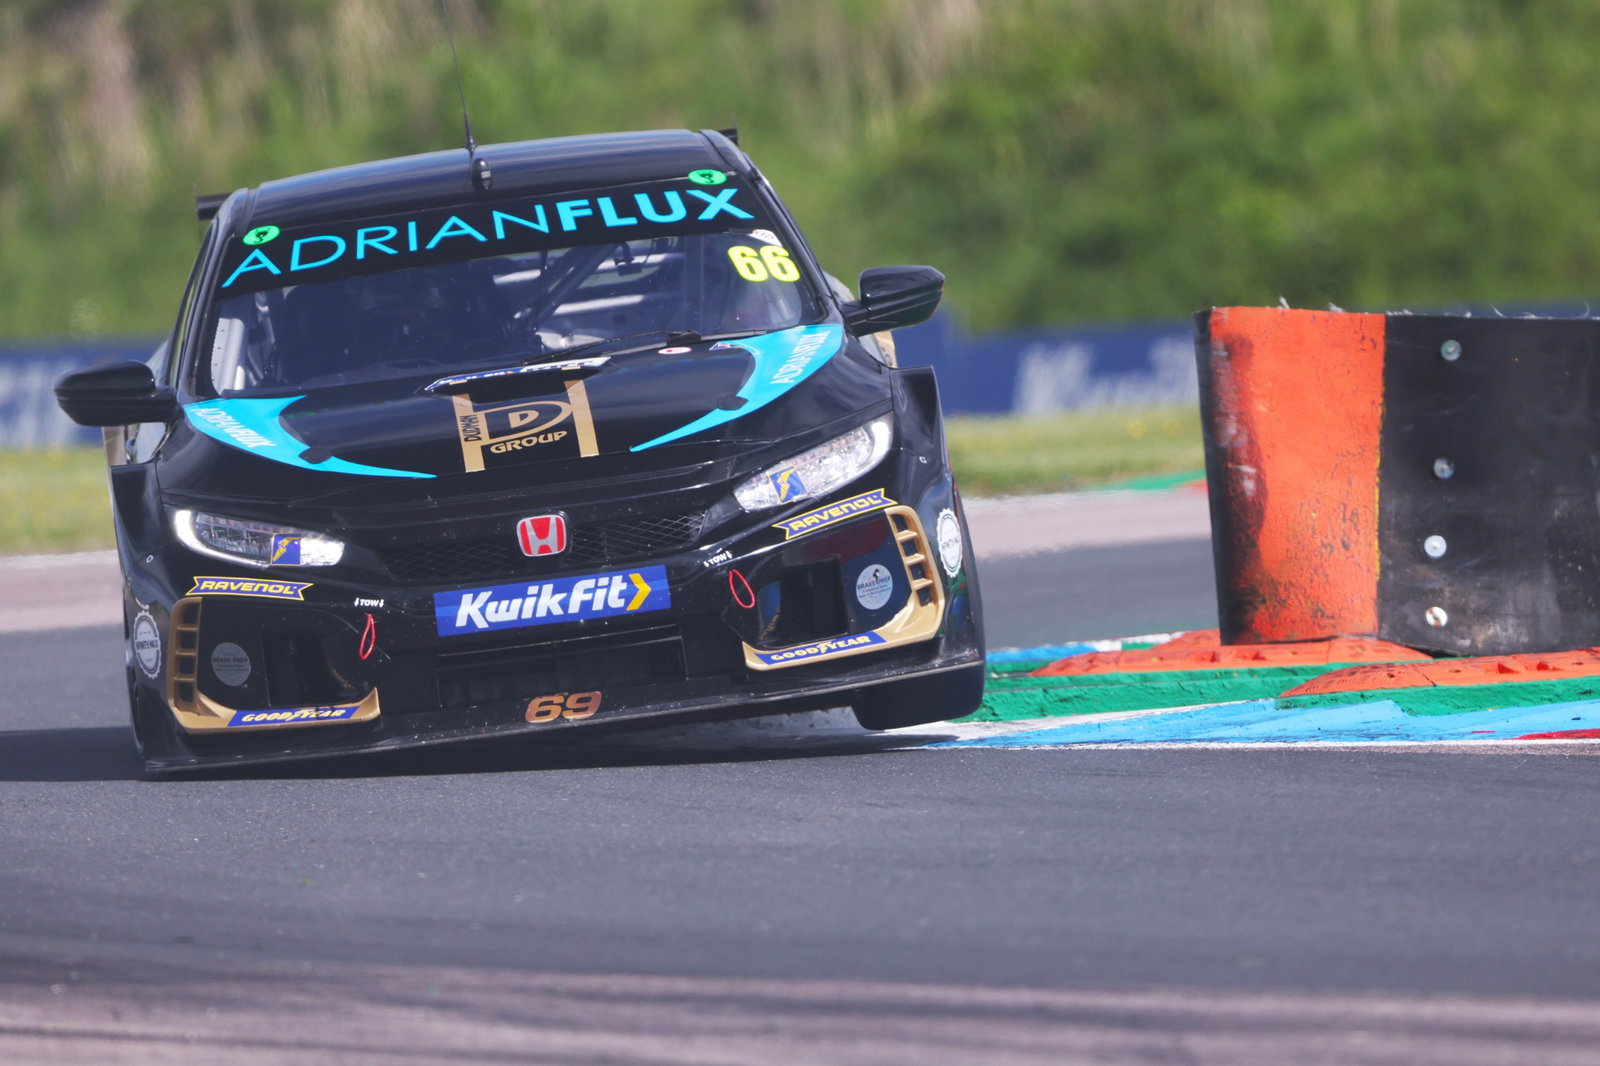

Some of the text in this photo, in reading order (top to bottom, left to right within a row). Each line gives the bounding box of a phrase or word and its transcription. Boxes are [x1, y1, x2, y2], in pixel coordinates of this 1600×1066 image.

[222, 188, 754, 287] ADRIANFLUX
[728, 246, 800, 282] 66
[490, 431, 568, 454] GROUP
[789, 495, 882, 531] RAVENOL
[708, 553, 727, 565] TOW
[200, 579, 296, 595] RAVENOL
[771, 635, 871, 661] GOODYEAR
[241, 707, 346, 722] GOODYEAR
[525, 691, 602, 723] 69
